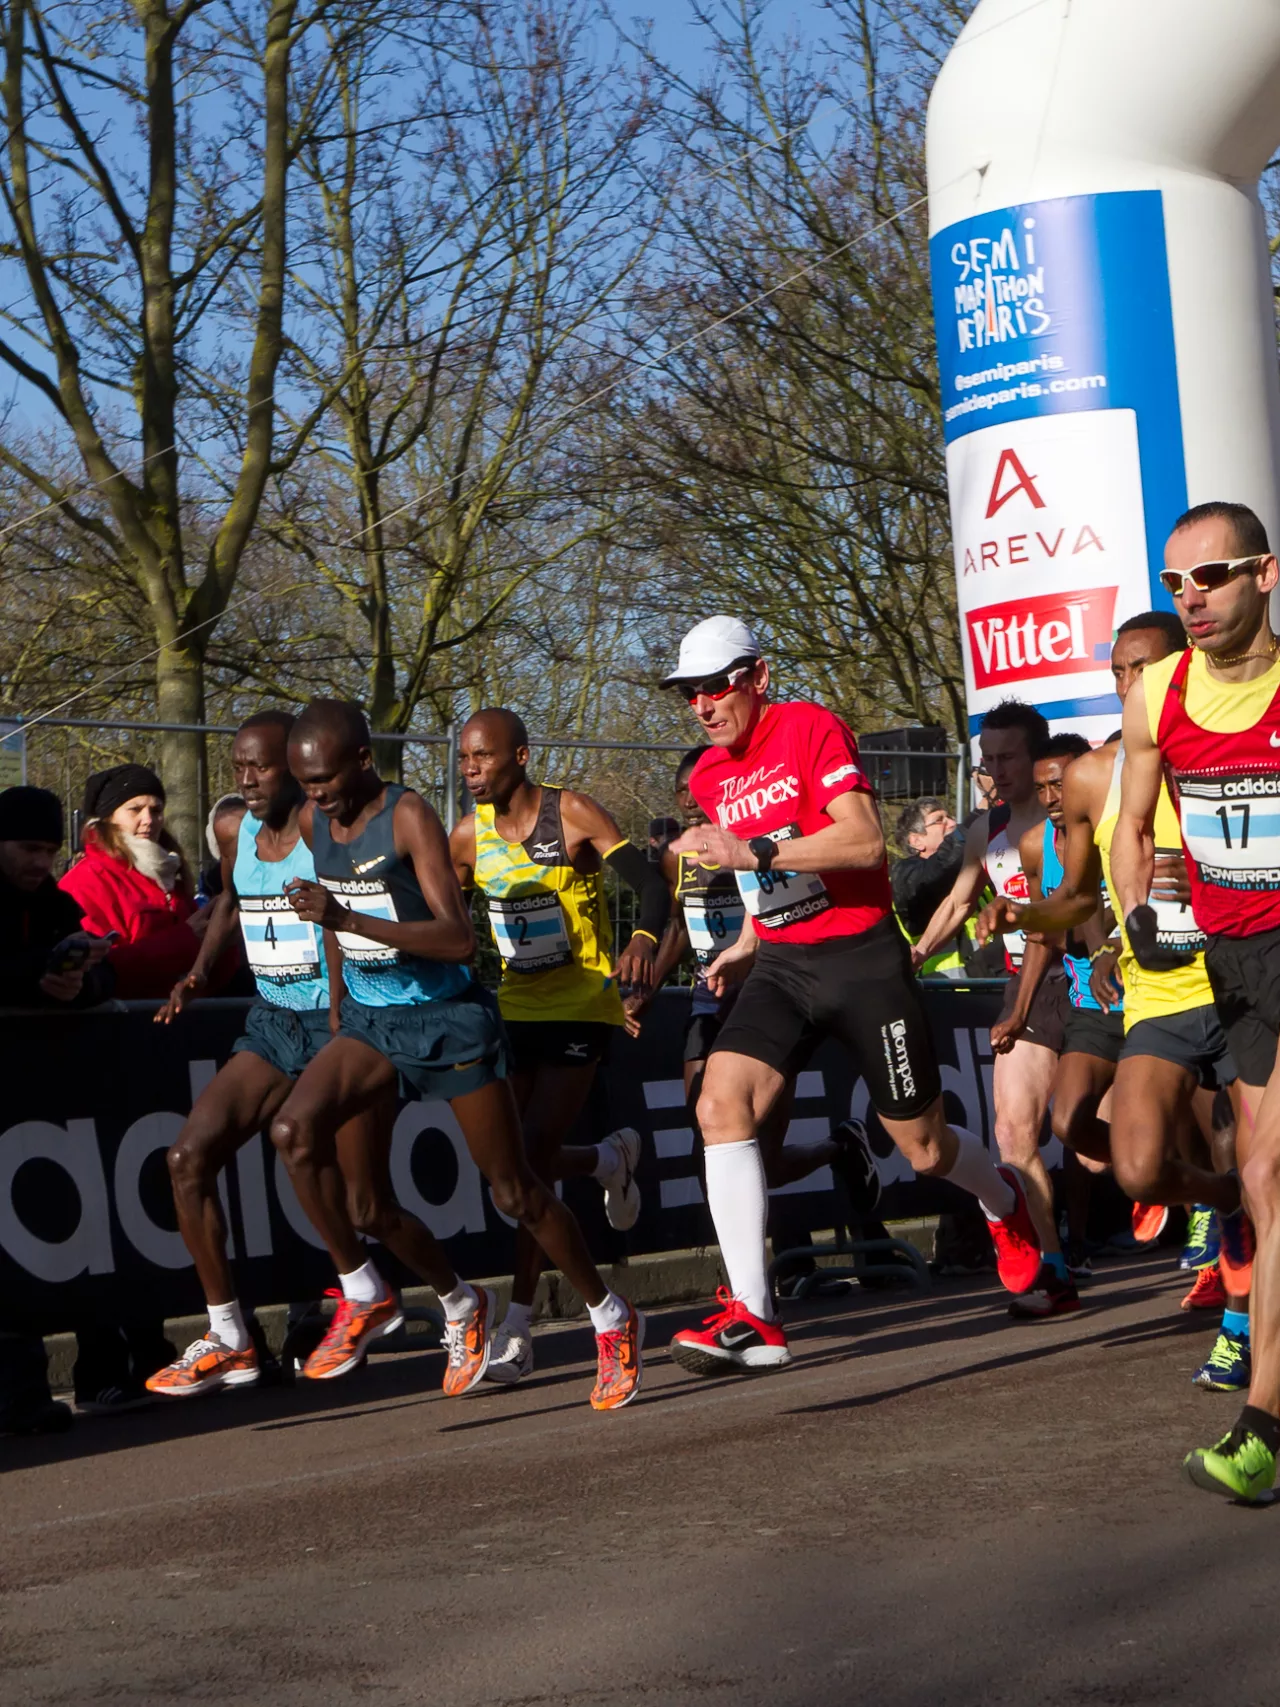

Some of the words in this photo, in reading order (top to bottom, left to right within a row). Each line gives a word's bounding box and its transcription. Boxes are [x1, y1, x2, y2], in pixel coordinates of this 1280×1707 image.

[963, 524, 1105, 577] AREVA
[971, 603, 1089, 675] Vittel
[719, 763, 784, 802] Team
[1215, 804, 1250, 849] 17
[341, 880, 384, 894] adidas
[708, 895, 743, 907] adida
[512, 895, 557, 911] adidas
[784, 898, 829, 922] adidas
[264, 916, 279, 950] 4
[514, 915, 532, 946] 2
[704, 910, 727, 939] 13
[1156, 931, 1208, 944] WERA
[340, 947, 399, 961] WERADE
[889, 1019, 917, 1098] Compex
[0, 1058, 563, 1284] adia
